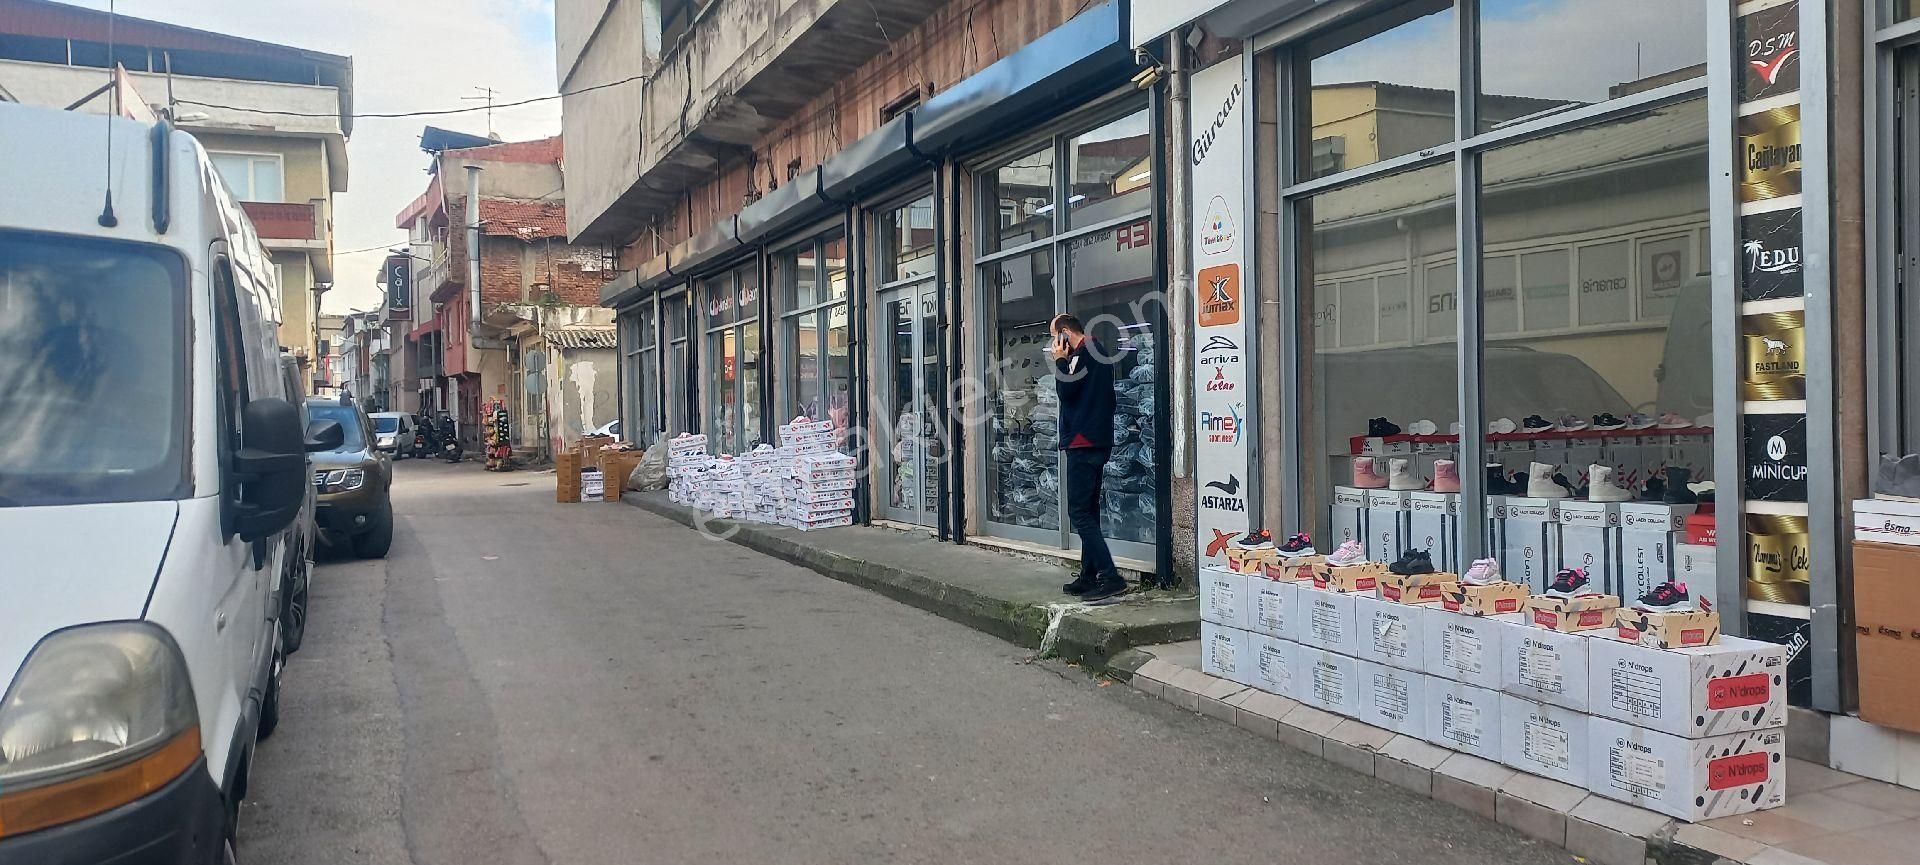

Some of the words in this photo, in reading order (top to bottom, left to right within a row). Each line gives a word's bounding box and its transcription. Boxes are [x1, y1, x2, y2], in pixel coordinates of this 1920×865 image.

[1192, 82, 1241, 166] Gürcan
[1760, 247, 1799, 267] EDU
[1200, 354, 1239, 365] arriva
[1755, 361, 1800, 371] FASTLAND
[1201, 495, 1245, 512] ASTARZA
[1729, 685, 1767, 698] N'drops
[1626, 740, 1652, 754] N'drops
[1728, 763, 1765, 778] N'drops
